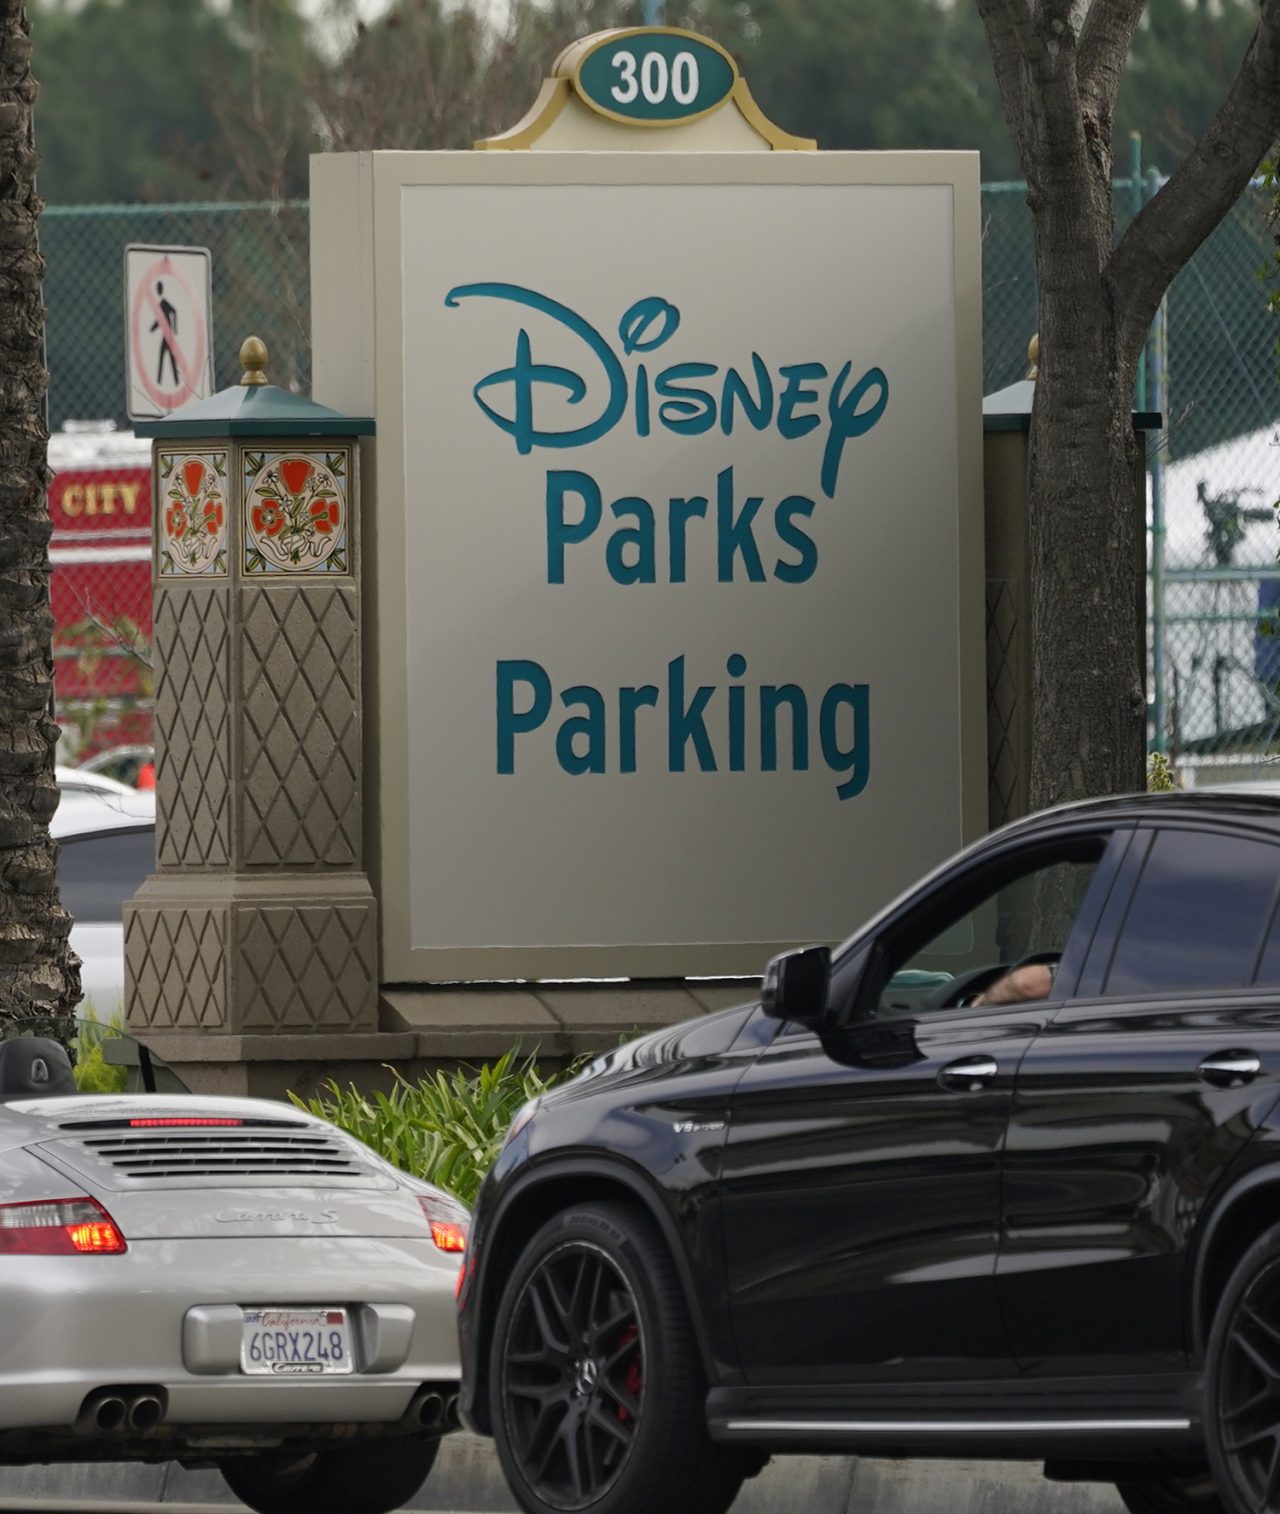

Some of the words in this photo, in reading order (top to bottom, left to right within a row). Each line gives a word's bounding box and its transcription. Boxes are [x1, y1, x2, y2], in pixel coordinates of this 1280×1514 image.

[610, 50, 700, 106] 300
[444, 282, 890, 498] Disney
[62, 484, 140, 517] CITY
[546, 466, 819, 586] Parks
[496, 654, 872, 801] Parking
[250, 1331, 344, 1362] 6GRX248
